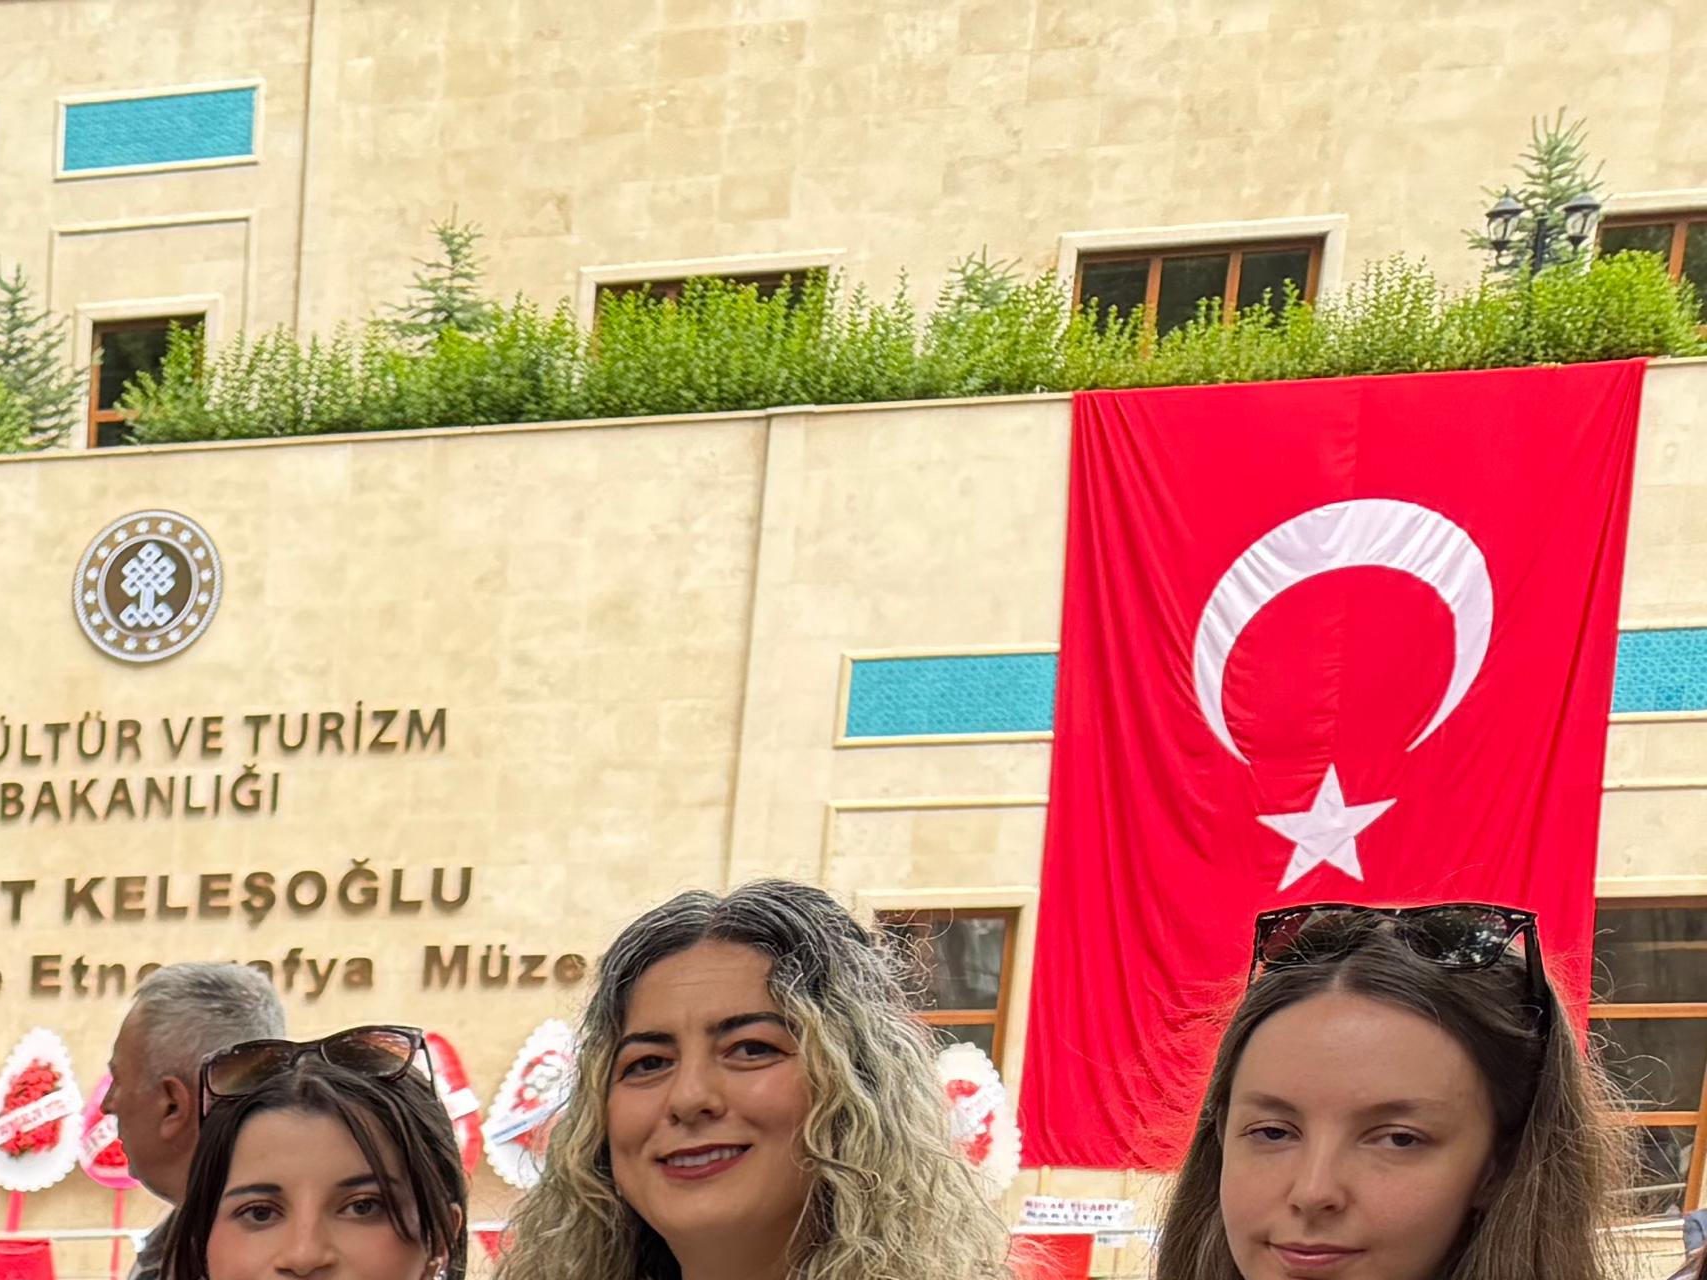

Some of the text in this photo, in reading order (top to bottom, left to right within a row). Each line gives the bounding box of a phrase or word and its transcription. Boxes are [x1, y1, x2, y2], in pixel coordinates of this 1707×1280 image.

[161, 716, 224, 759] VE
[243, 700, 447, 757] TURİZM
[0, 762, 280, 822] BAKANLIĞI
[64, 857, 473, 929] KELEŞOĞLU
[422, 943, 587, 991] Müze
